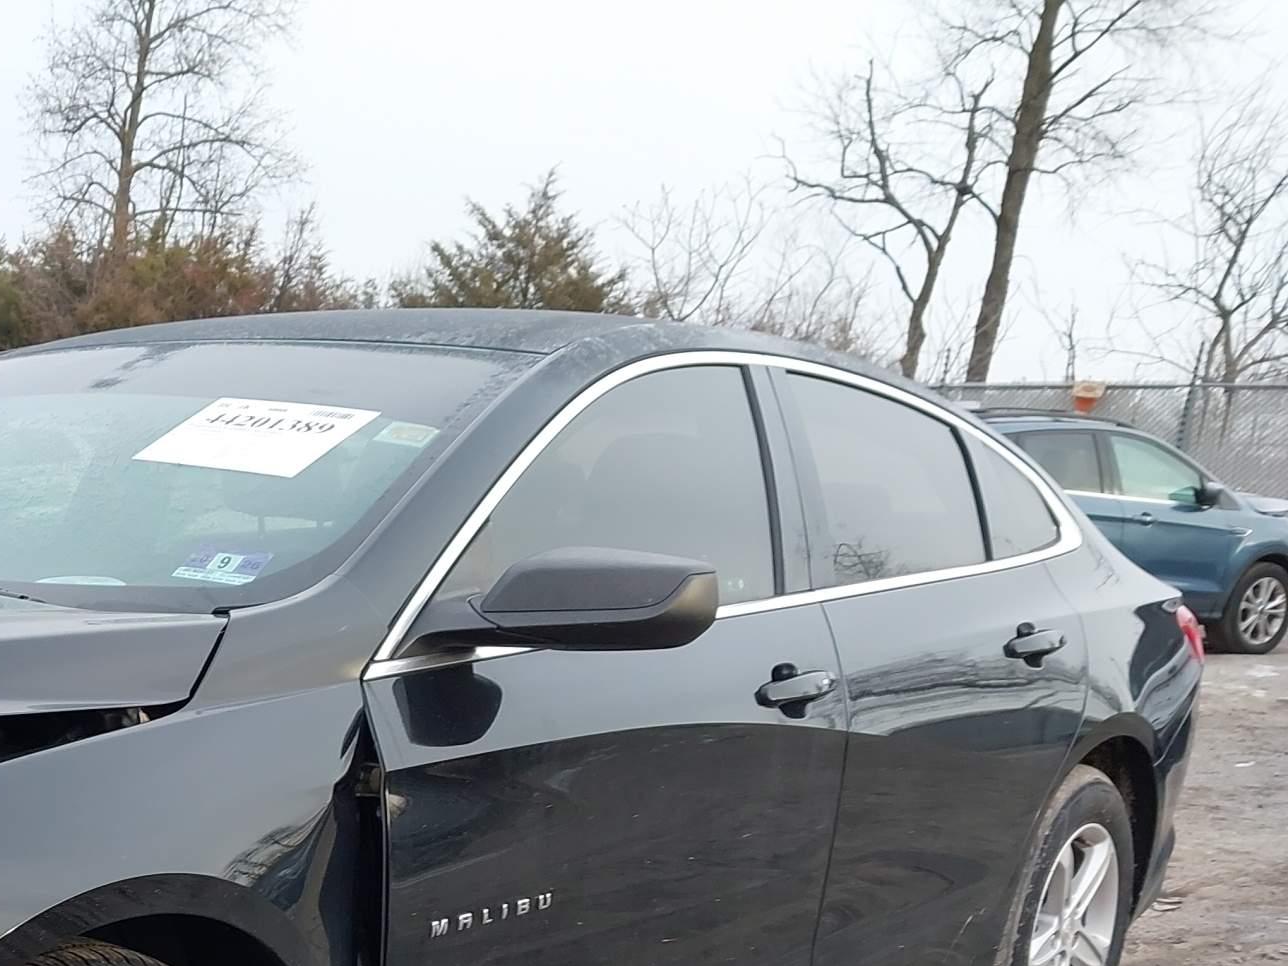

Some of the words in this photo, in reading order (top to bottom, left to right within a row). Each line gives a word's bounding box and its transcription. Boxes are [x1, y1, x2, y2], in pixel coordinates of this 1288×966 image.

[204, 412, 336, 434] 44201389
[217, 556, 233, 569] 9
[429, 892, 554, 939] MALIBU
